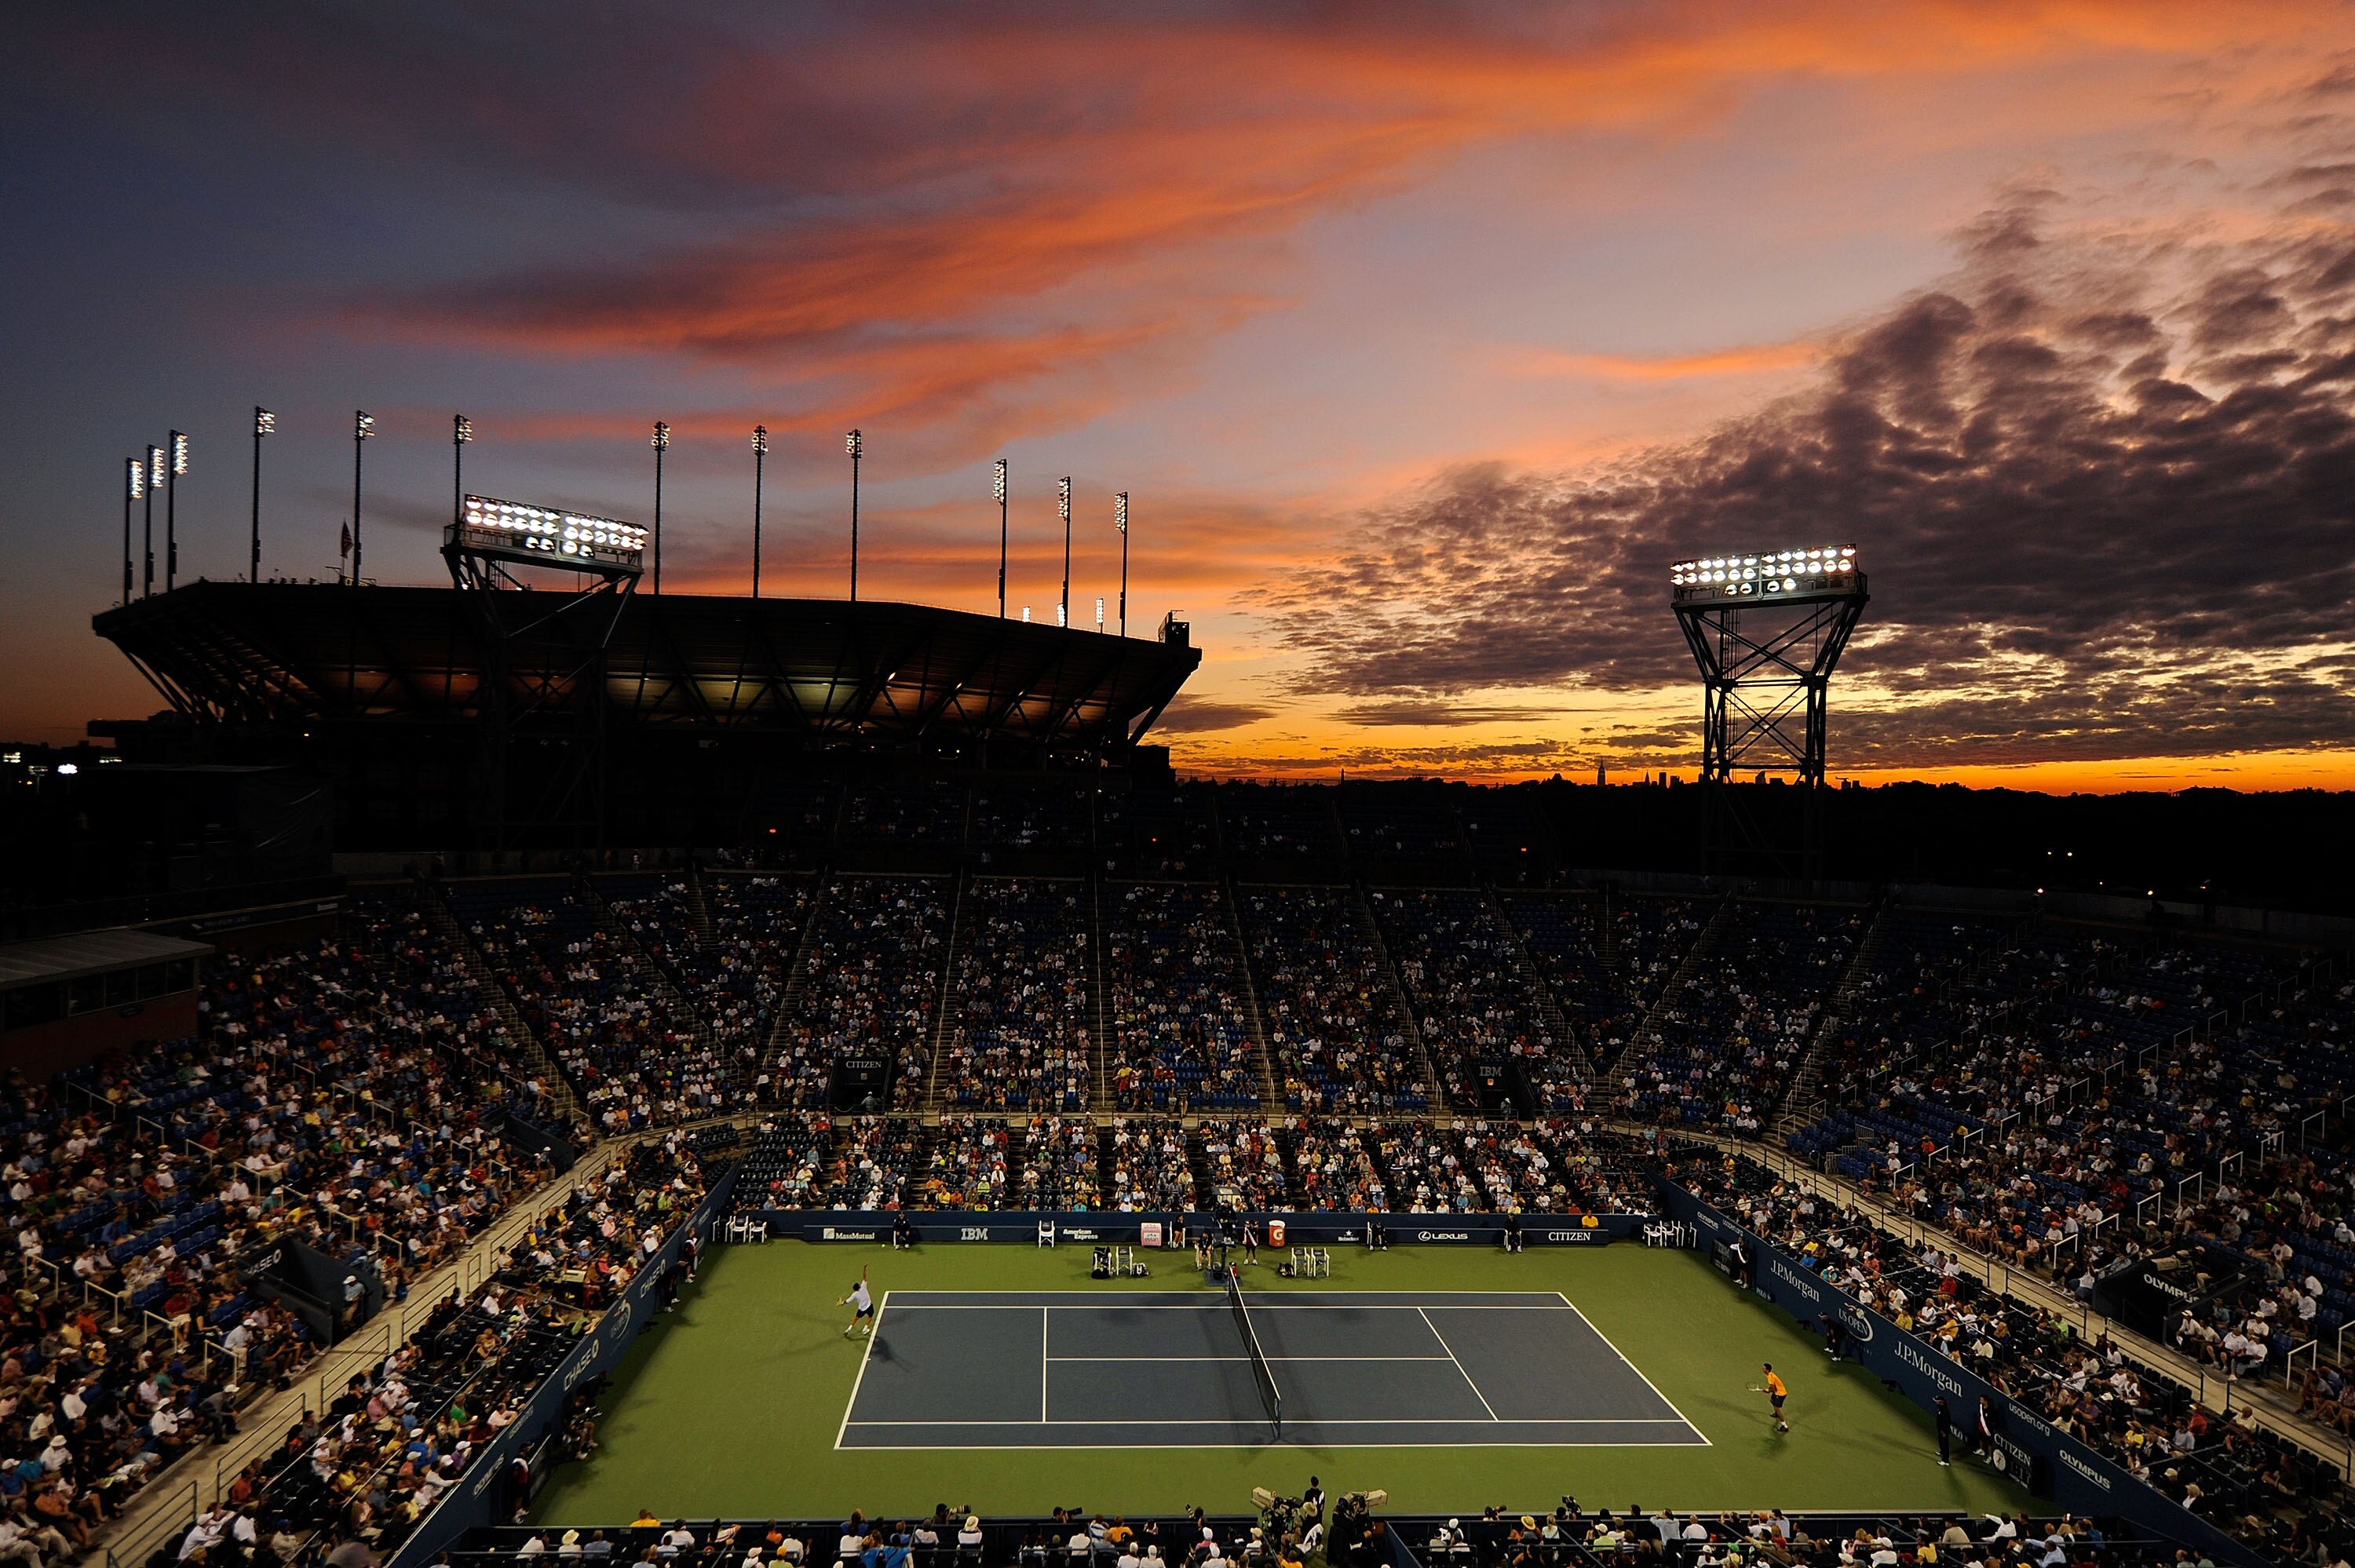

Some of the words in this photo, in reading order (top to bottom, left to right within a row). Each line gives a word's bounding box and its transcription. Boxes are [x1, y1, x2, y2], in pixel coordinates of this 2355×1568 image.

[1479, 1066, 1502, 1077] IBM
[835, 1231, 875, 1240] MassMutual
[960, 1227, 988, 1241] IBM
[1272, 1228, 1283, 1241] G
[1548, 1231, 1591, 1242] CITIZEN
[640, 1265, 660, 1299] CHASE
[1838, 1308, 1847, 1322] US
[1848, 1315, 1868, 1336] OPEN
[564, 1347, 592, 1391] CHASE
[2009, 1402, 2050, 1437] usopen.org
[1994, 1433, 2031, 1467] CITIZEN
[2059, 1449, 2111, 1490] OLYMPUS
